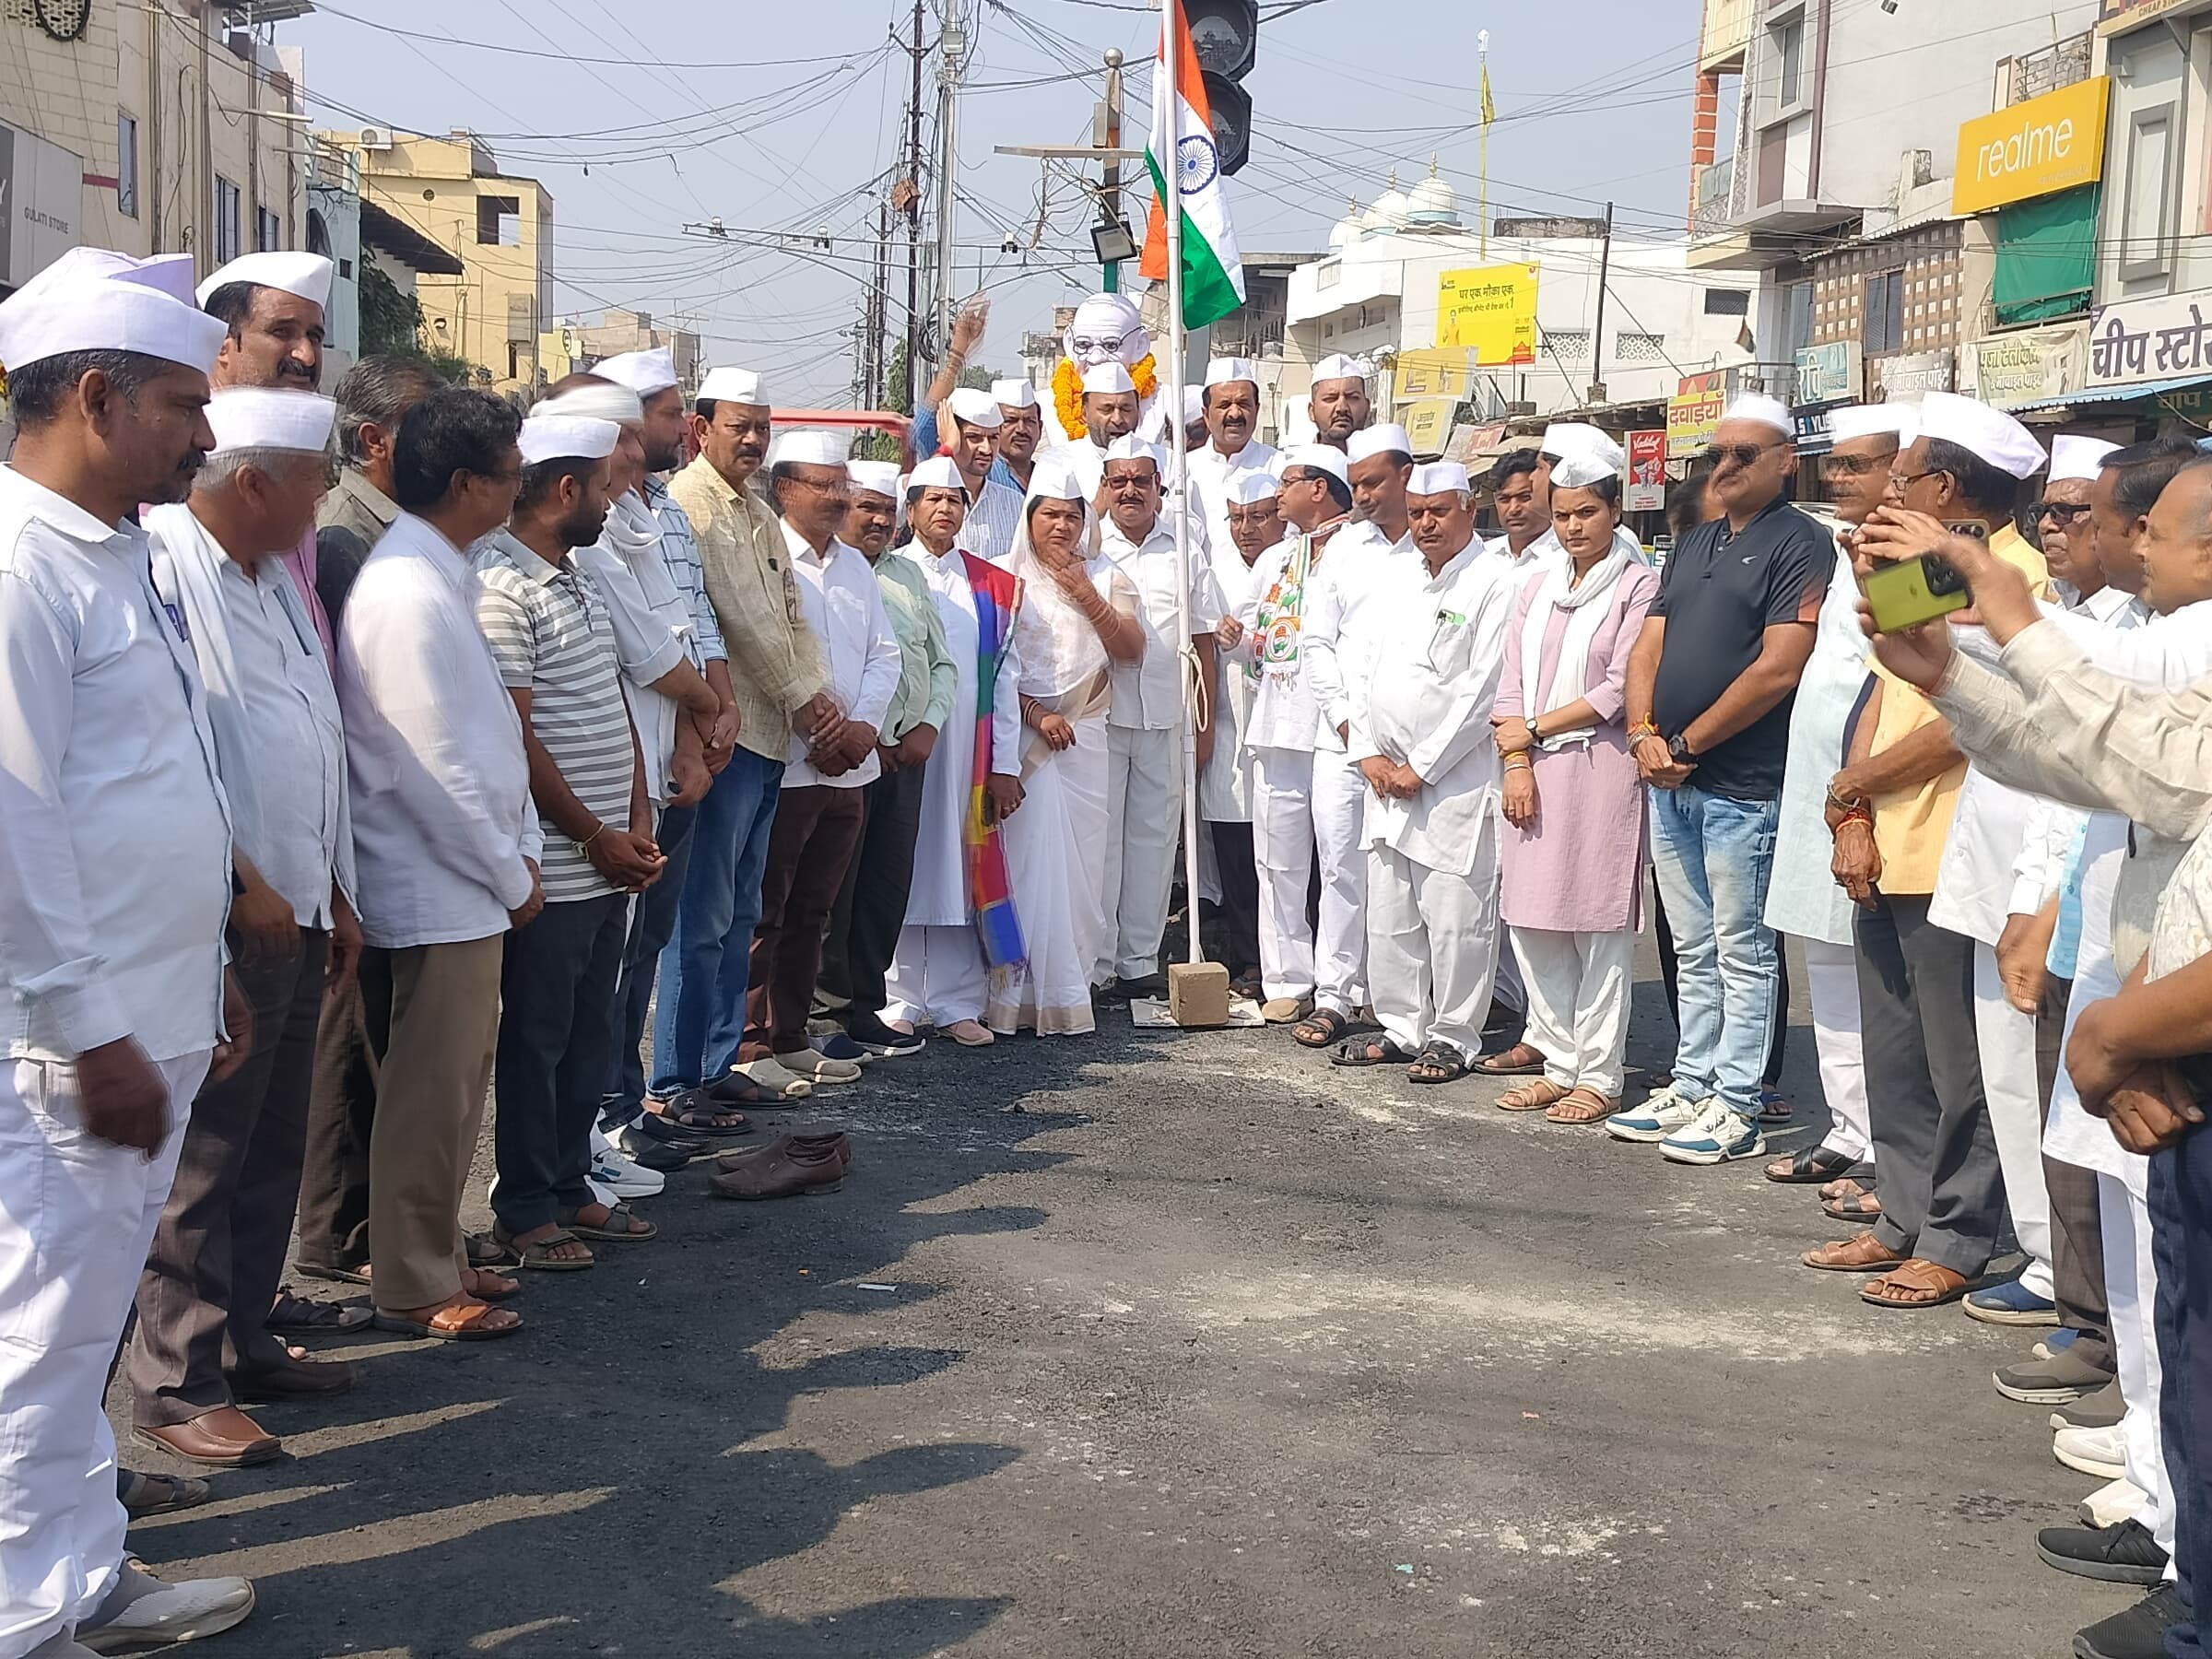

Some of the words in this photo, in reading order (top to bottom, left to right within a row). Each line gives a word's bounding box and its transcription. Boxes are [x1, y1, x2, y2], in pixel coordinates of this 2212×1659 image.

[1976, 118, 2073, 182] realme
[24, 206, 47, 228] GULATI
[49, 215, 69, 234] STORE
[2092, 317, 2150, 379] चीप
[1669, 390, 1724, 427] दवाईयाँ
